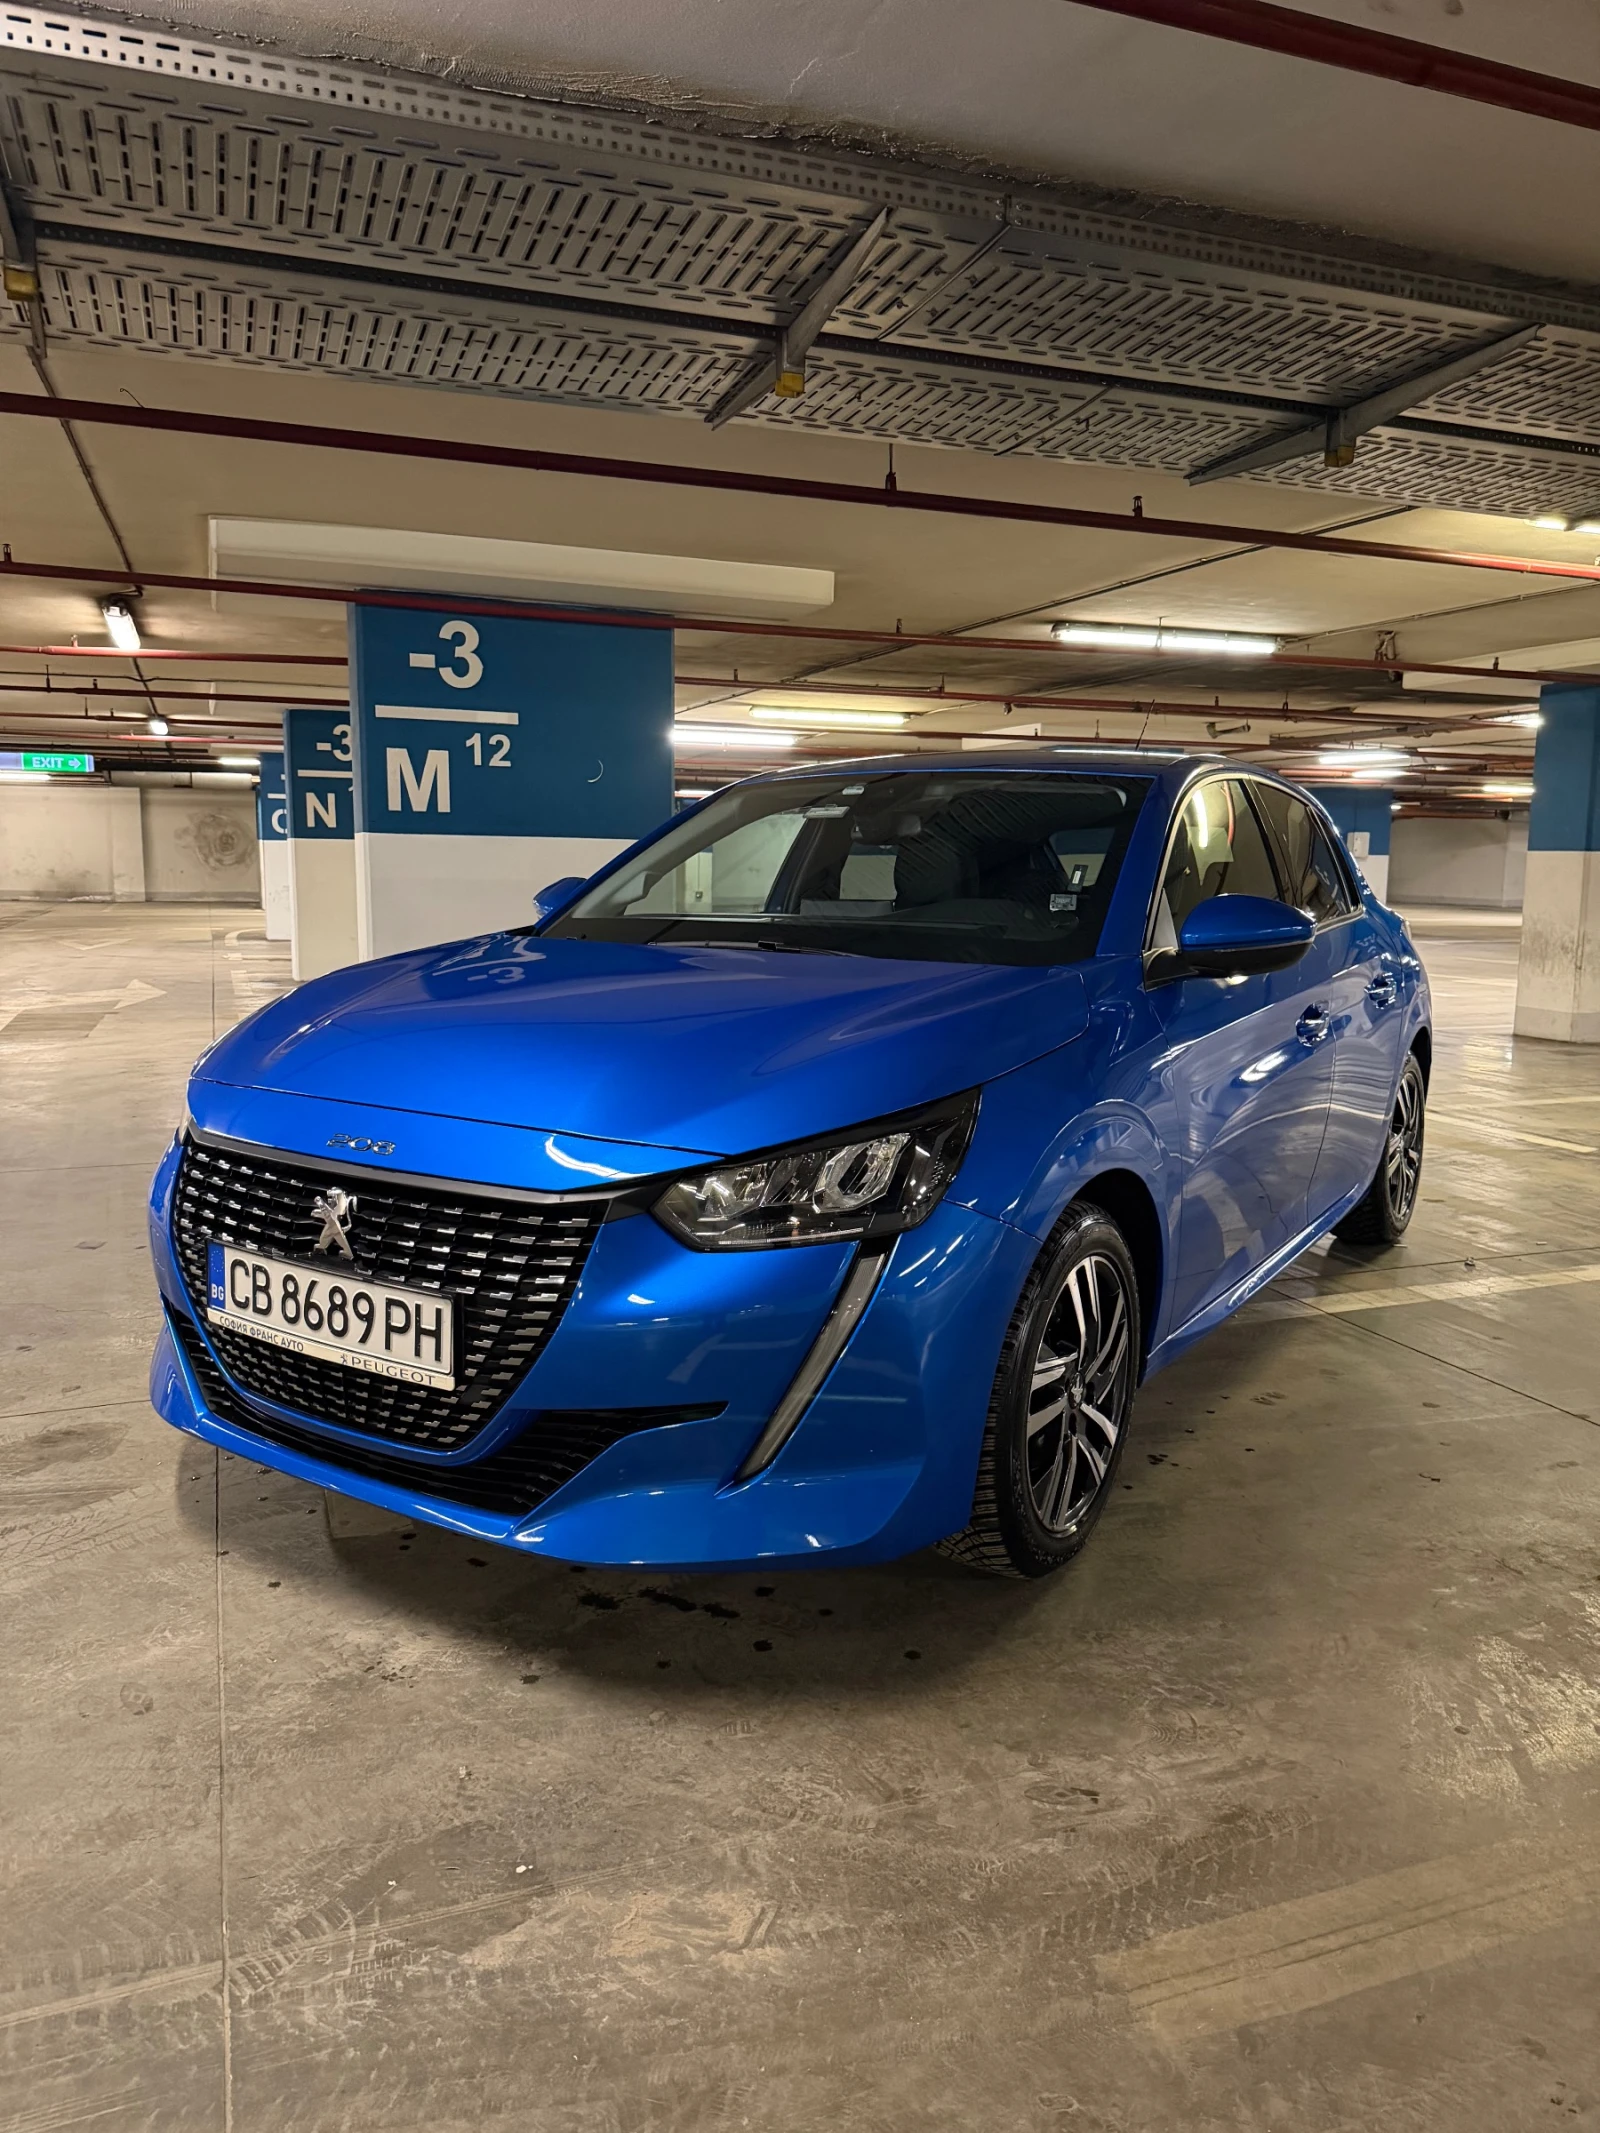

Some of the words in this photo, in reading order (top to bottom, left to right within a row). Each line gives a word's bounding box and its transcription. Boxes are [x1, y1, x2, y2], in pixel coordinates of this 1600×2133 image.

[409, 620, 484, 689] -3
[32, 757, 64, 769] EXIT
[386, 747, 451, 813] M
[465, 732, 512, 767] 12
[305, 792, 337, 828] N
[326, 1133, 396, 1155] 208
[211, 1283, 225, 1301] BG
[281, 1273, 375, 1343] 8689
[219, 1315, 248, 1334] СОФИЯ
[249, 1327, 279, 1345] ФРАНС
[280, 1337, 304, 1352] АУТО
[351, 1356, 436, 1386] PEUGEOT
